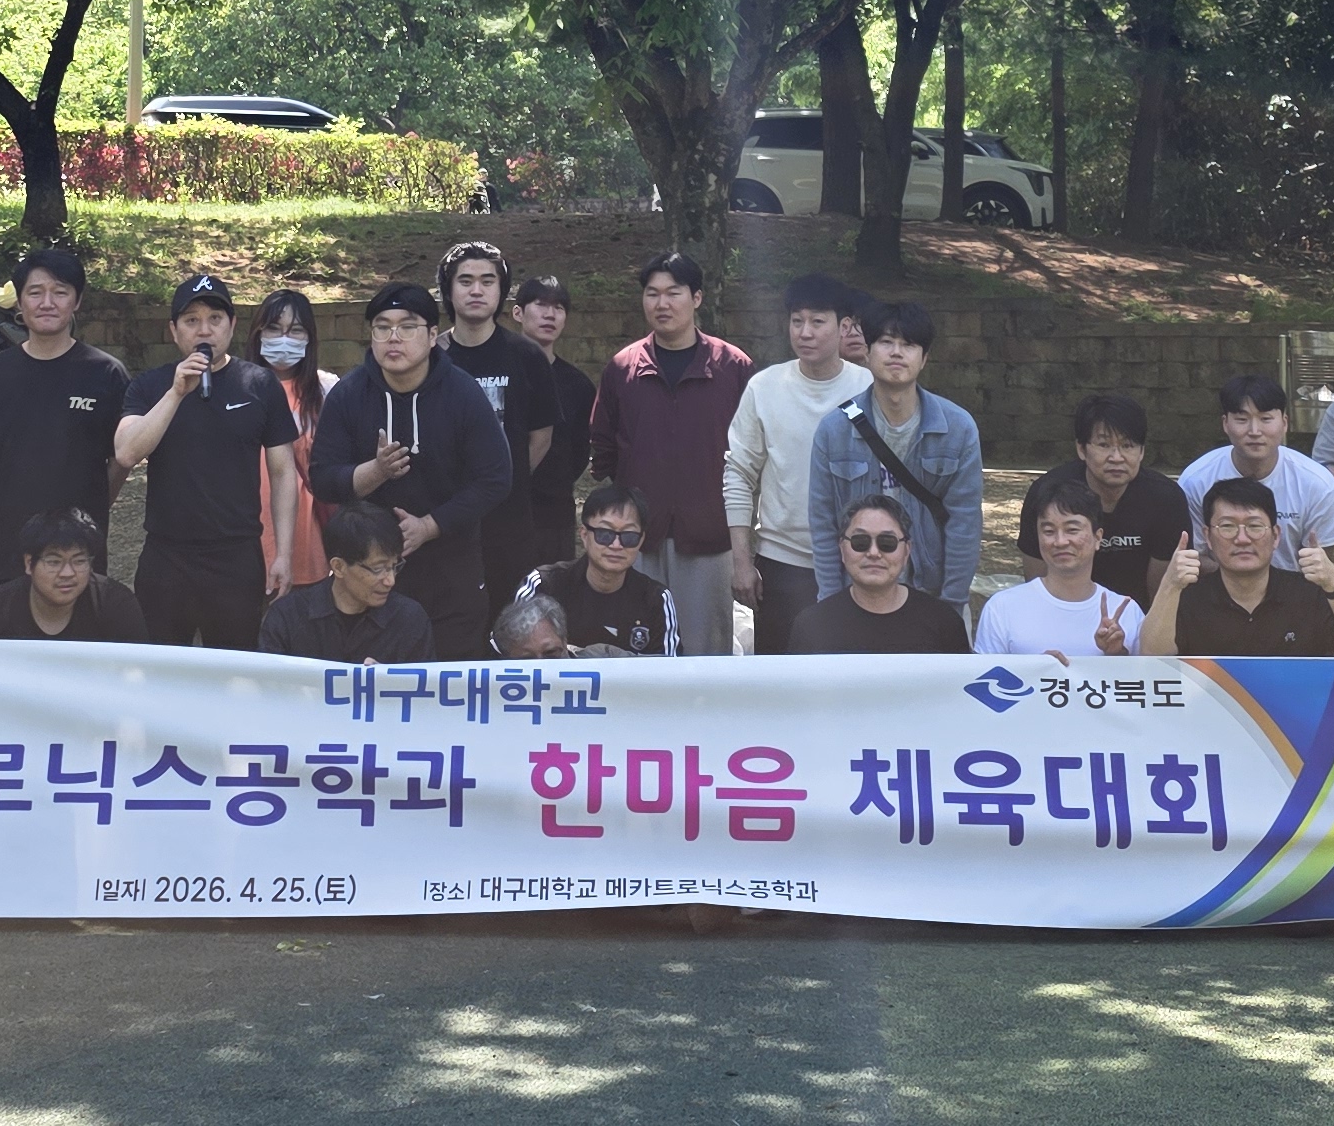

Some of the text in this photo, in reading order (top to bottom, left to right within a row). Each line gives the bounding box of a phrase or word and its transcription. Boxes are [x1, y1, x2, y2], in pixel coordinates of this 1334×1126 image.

[69, 396, 97, 411] TKC
[324, 668, 607, 725] 대구대학교
[1040, 677, 1186, 709] 경상북도
[529, 742, 807, 842] 한마음
[849, 748, 1228, 852] 체육대회
[154, 877, 231, 903] 2026.
[240, 877, 263, 902] 4.
[479, 876, 598, 901] 대구대학교
[605, 878, 819, 903] 메카트로닉스공학과
